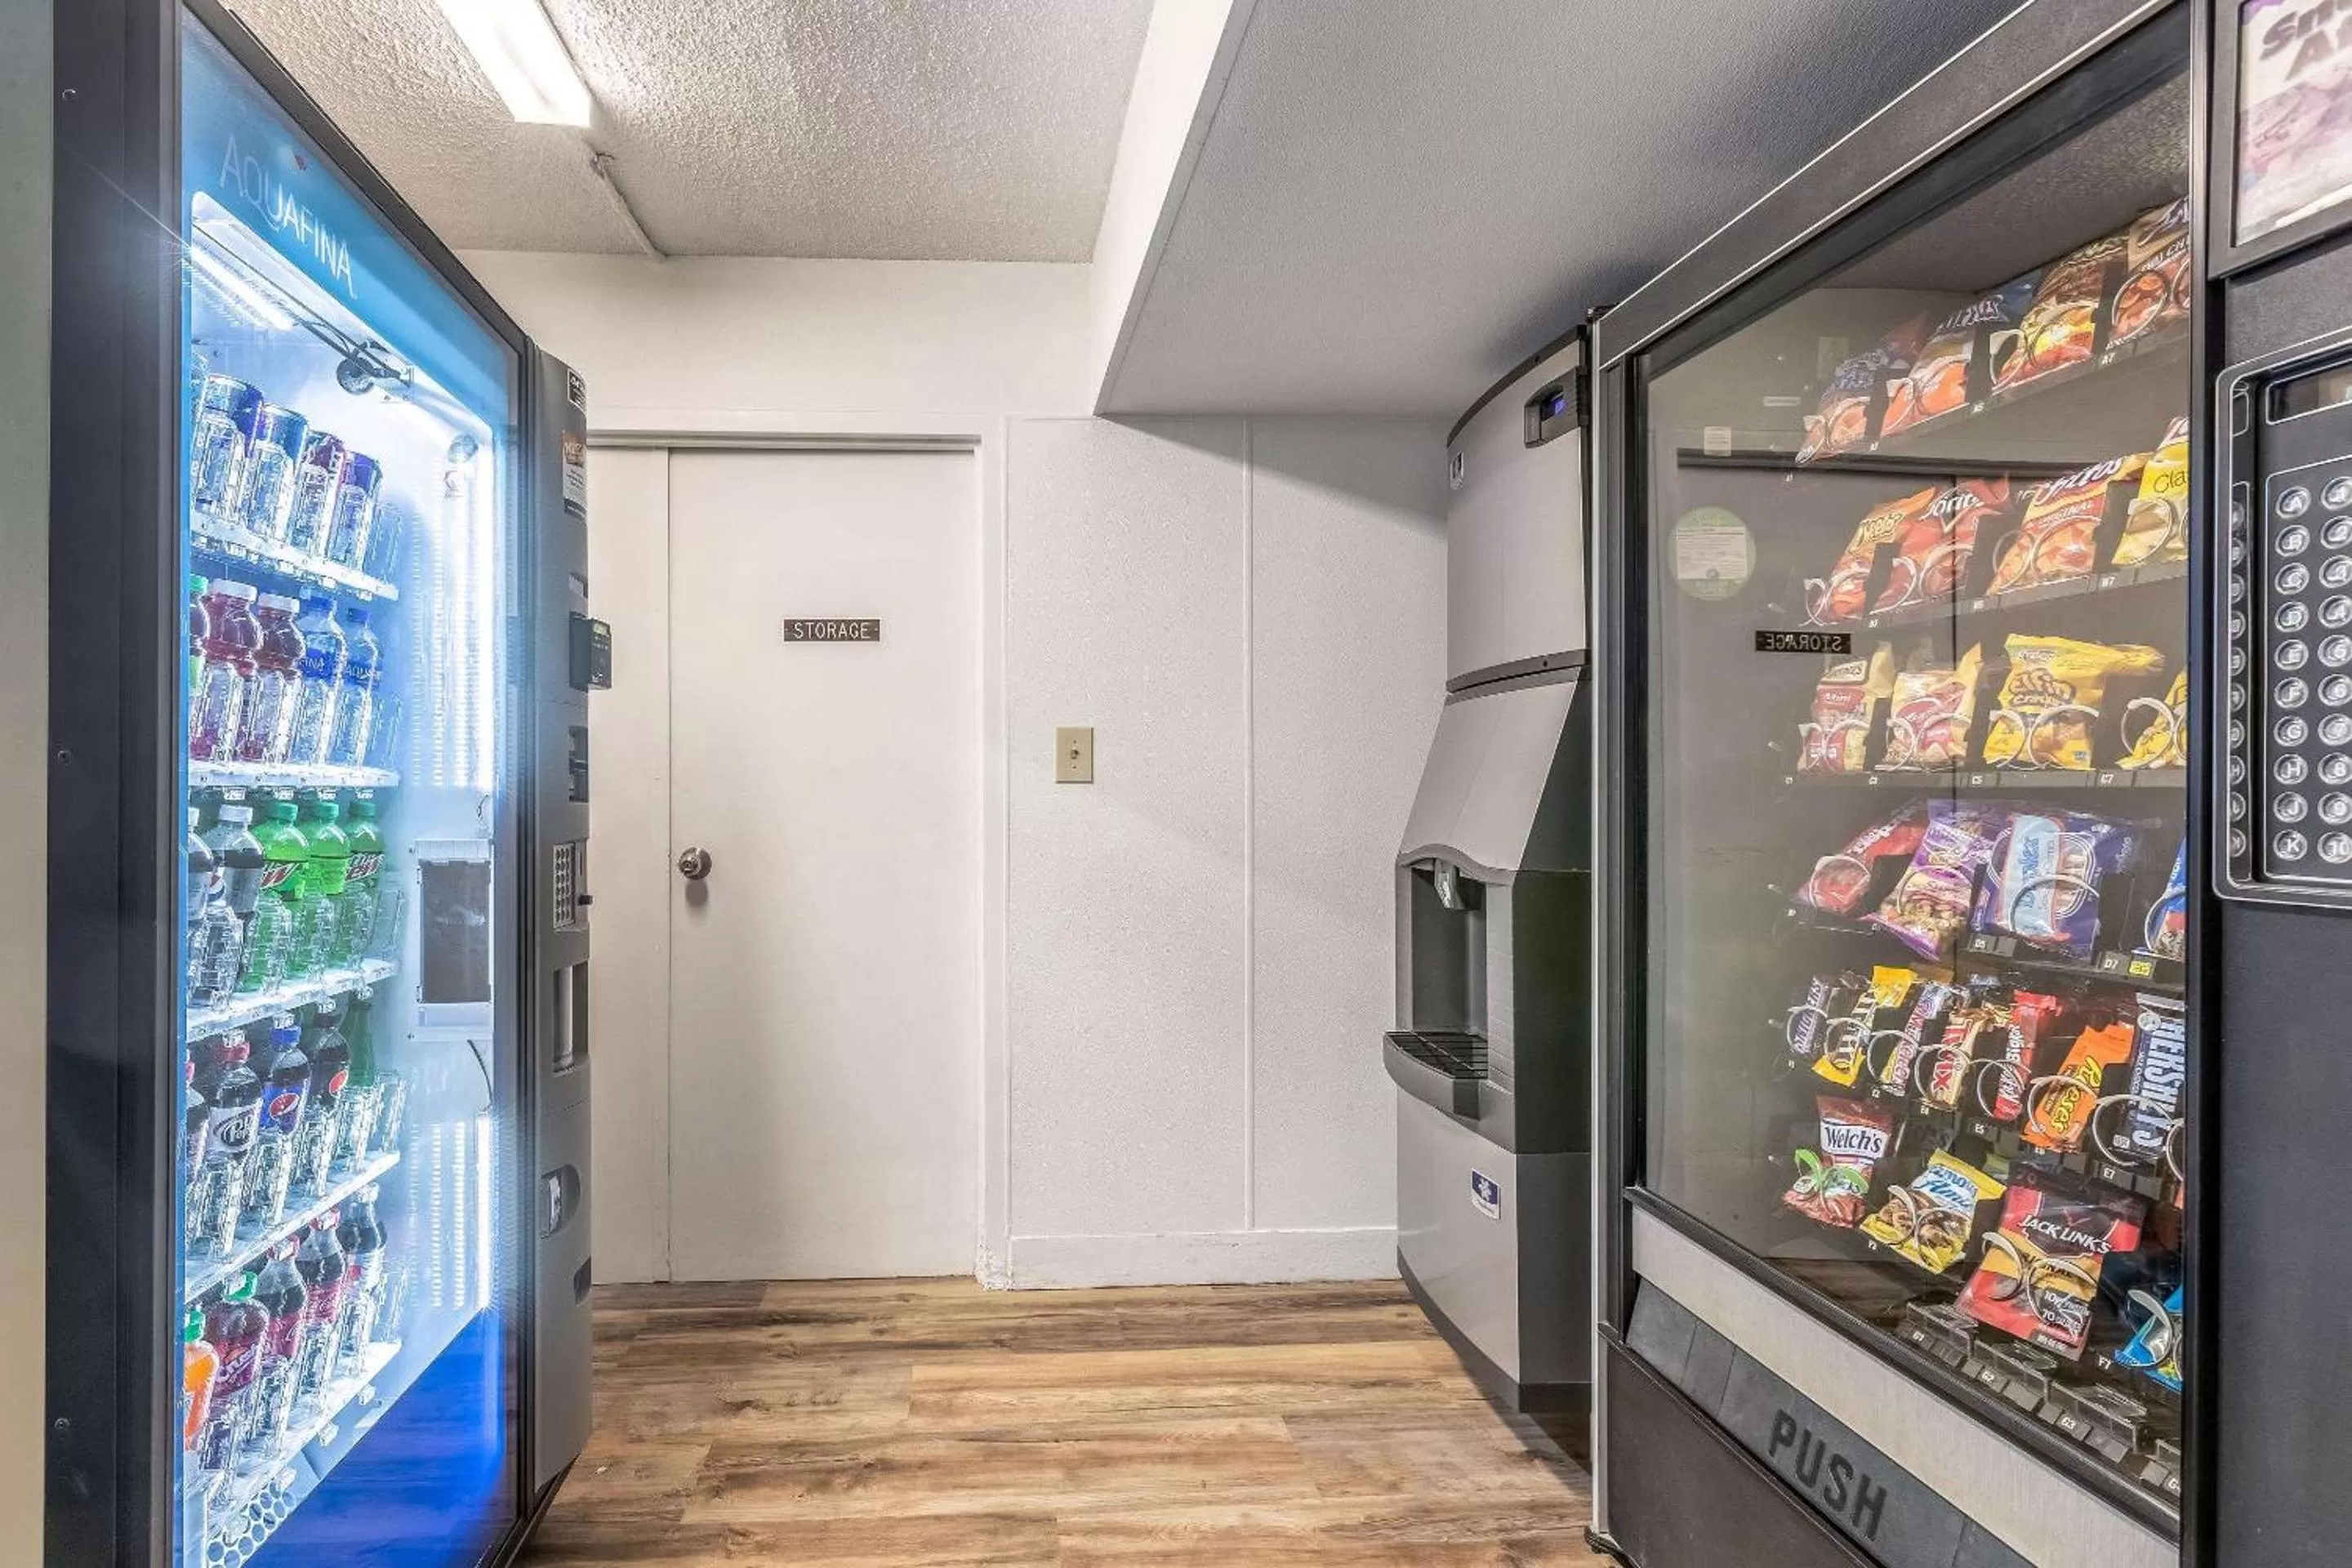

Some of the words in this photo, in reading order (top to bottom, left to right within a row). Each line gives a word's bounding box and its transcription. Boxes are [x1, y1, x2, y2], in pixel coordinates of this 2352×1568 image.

[220, 135, 357, 299] AQUAFINA
[793, 621, 871, 639] STORAGE
[1824, 1127, 1882, 1153] Welch's
[2017, 1214, 2061, 1239] JACK
[1769, 1408, 1887, 1542] PUSH
